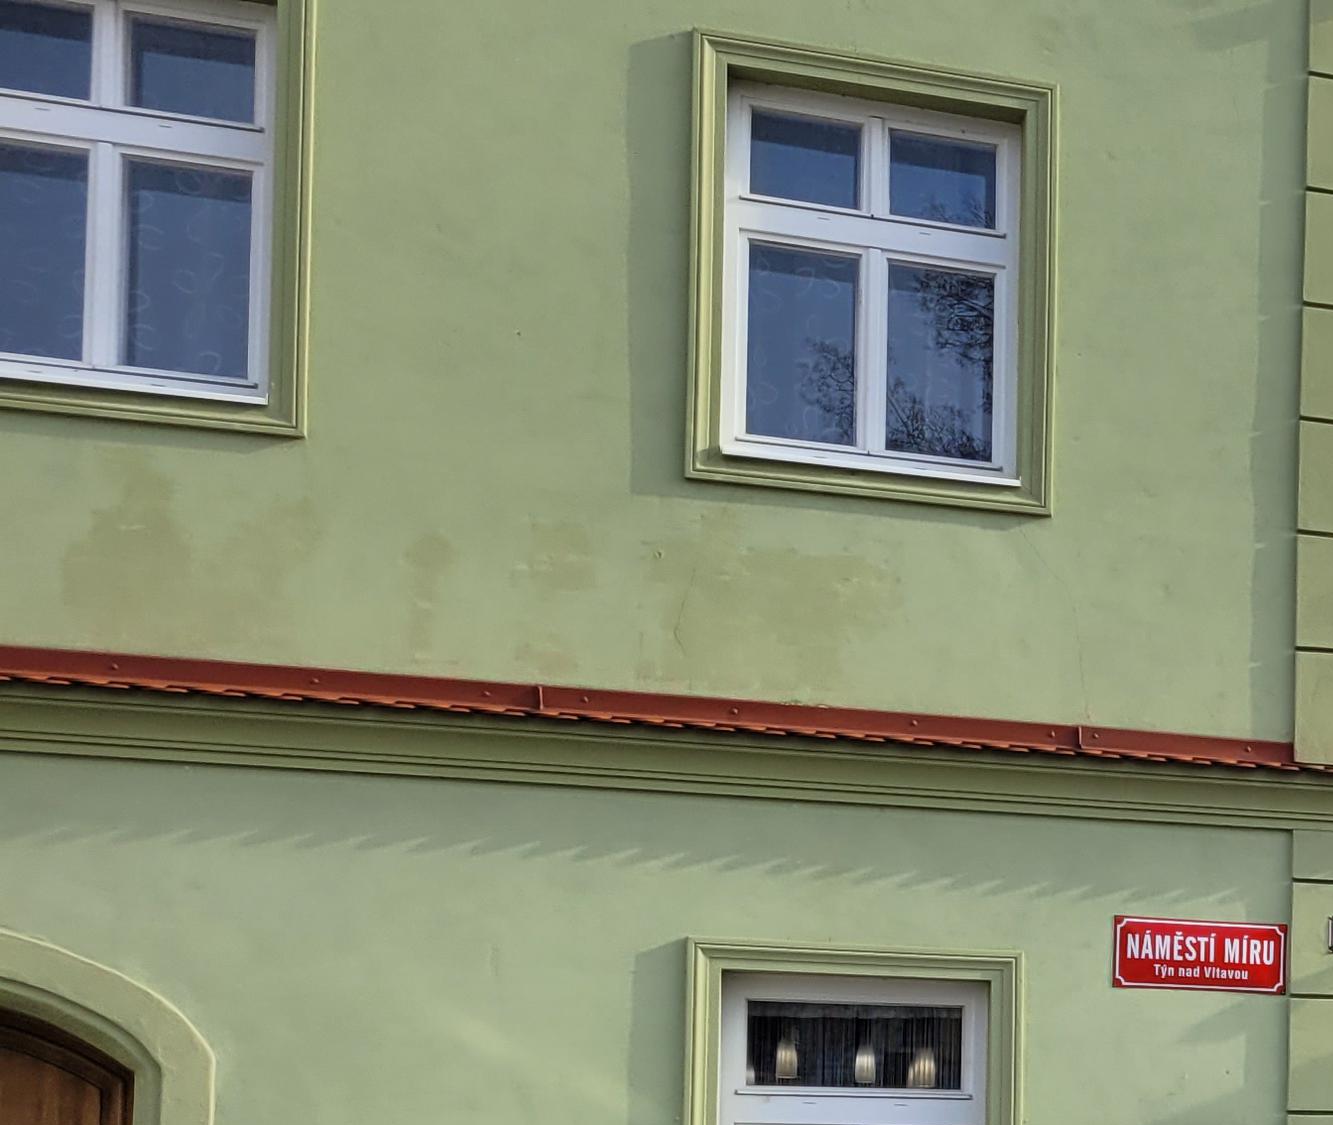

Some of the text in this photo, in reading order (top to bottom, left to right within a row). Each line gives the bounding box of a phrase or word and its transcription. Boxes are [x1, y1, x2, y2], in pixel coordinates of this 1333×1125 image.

[1126, 930, 1275, 965] NÁMĚSTÍ MÍRU
[1153, 963, 1249, 980] Týn nad Vltavou
